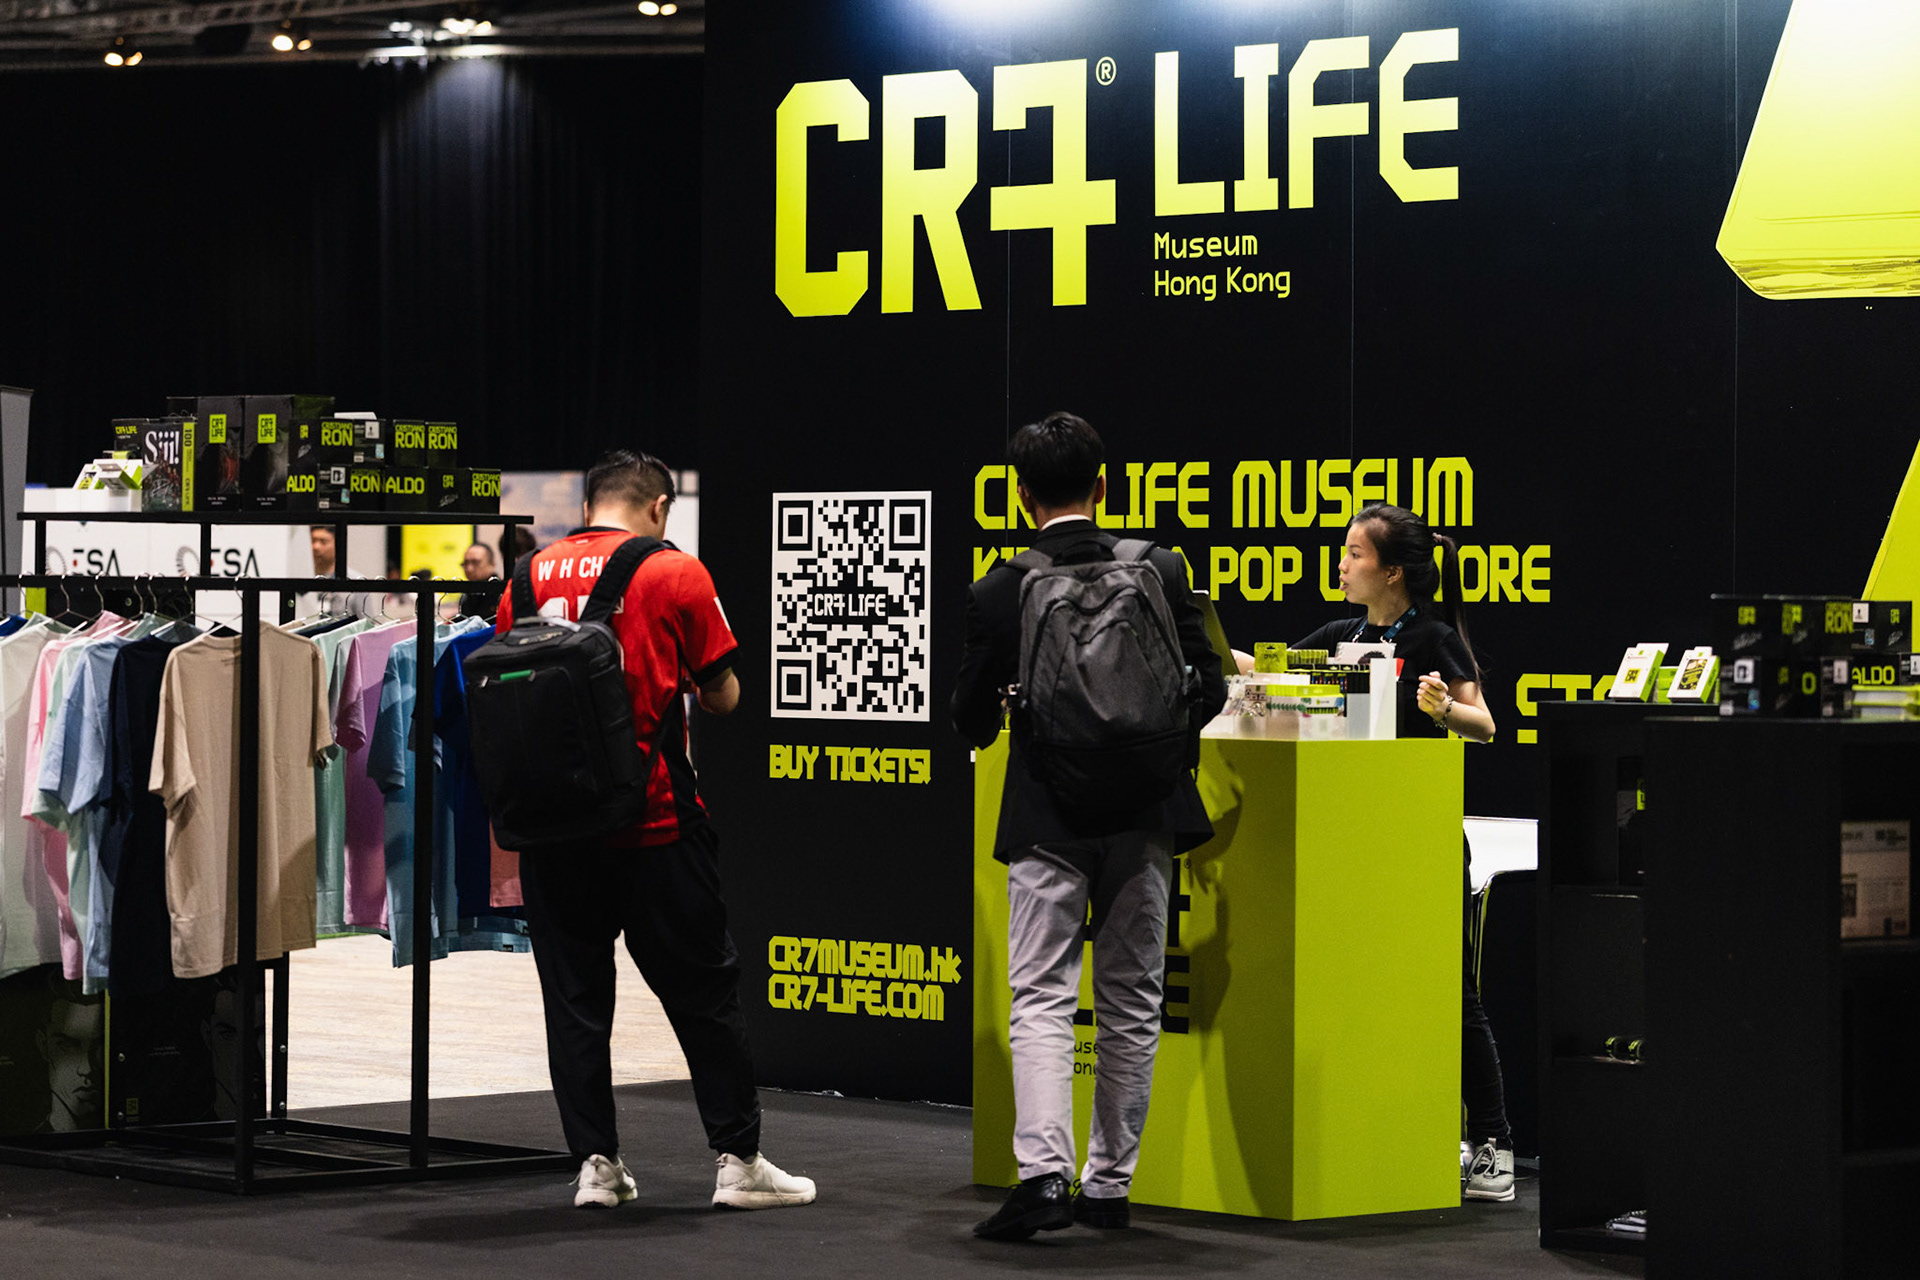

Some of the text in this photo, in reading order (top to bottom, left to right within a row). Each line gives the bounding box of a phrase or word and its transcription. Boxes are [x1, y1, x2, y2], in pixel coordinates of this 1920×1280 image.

[1154, 27, 1459, 216] LIFE
[1154, 232, 1258, 260] Museum
[1154, 266, 1291, 302] Hong Kong
[321, 430, 353, 447] RON
[395, 432, 425, 449] RON
[428, 433, 457, 450] RON
[286, 474, 316, 493] ALDO
[350, 476, 380, 493] RON
[385, 476, 425, 494] ALDO
[471, 480, 501, 497] RON
[1096, 461, 1210, 529] LIFE
[1232, 456, 1474, 528] MUSEUM
[537, 556, 611, 582] W H CH
[1210, 546, 1303, 602] POP
[1319, 545, 1349, 602] U
[814, 593, 886, 617] CR7 LIFE
[769, 744, 931, 785] BUY TICKETS!
[768, 935, 962, 985] CR7MUSEUM.hk
[768, 973, 945, 1021] CR7-LIFE.COM
